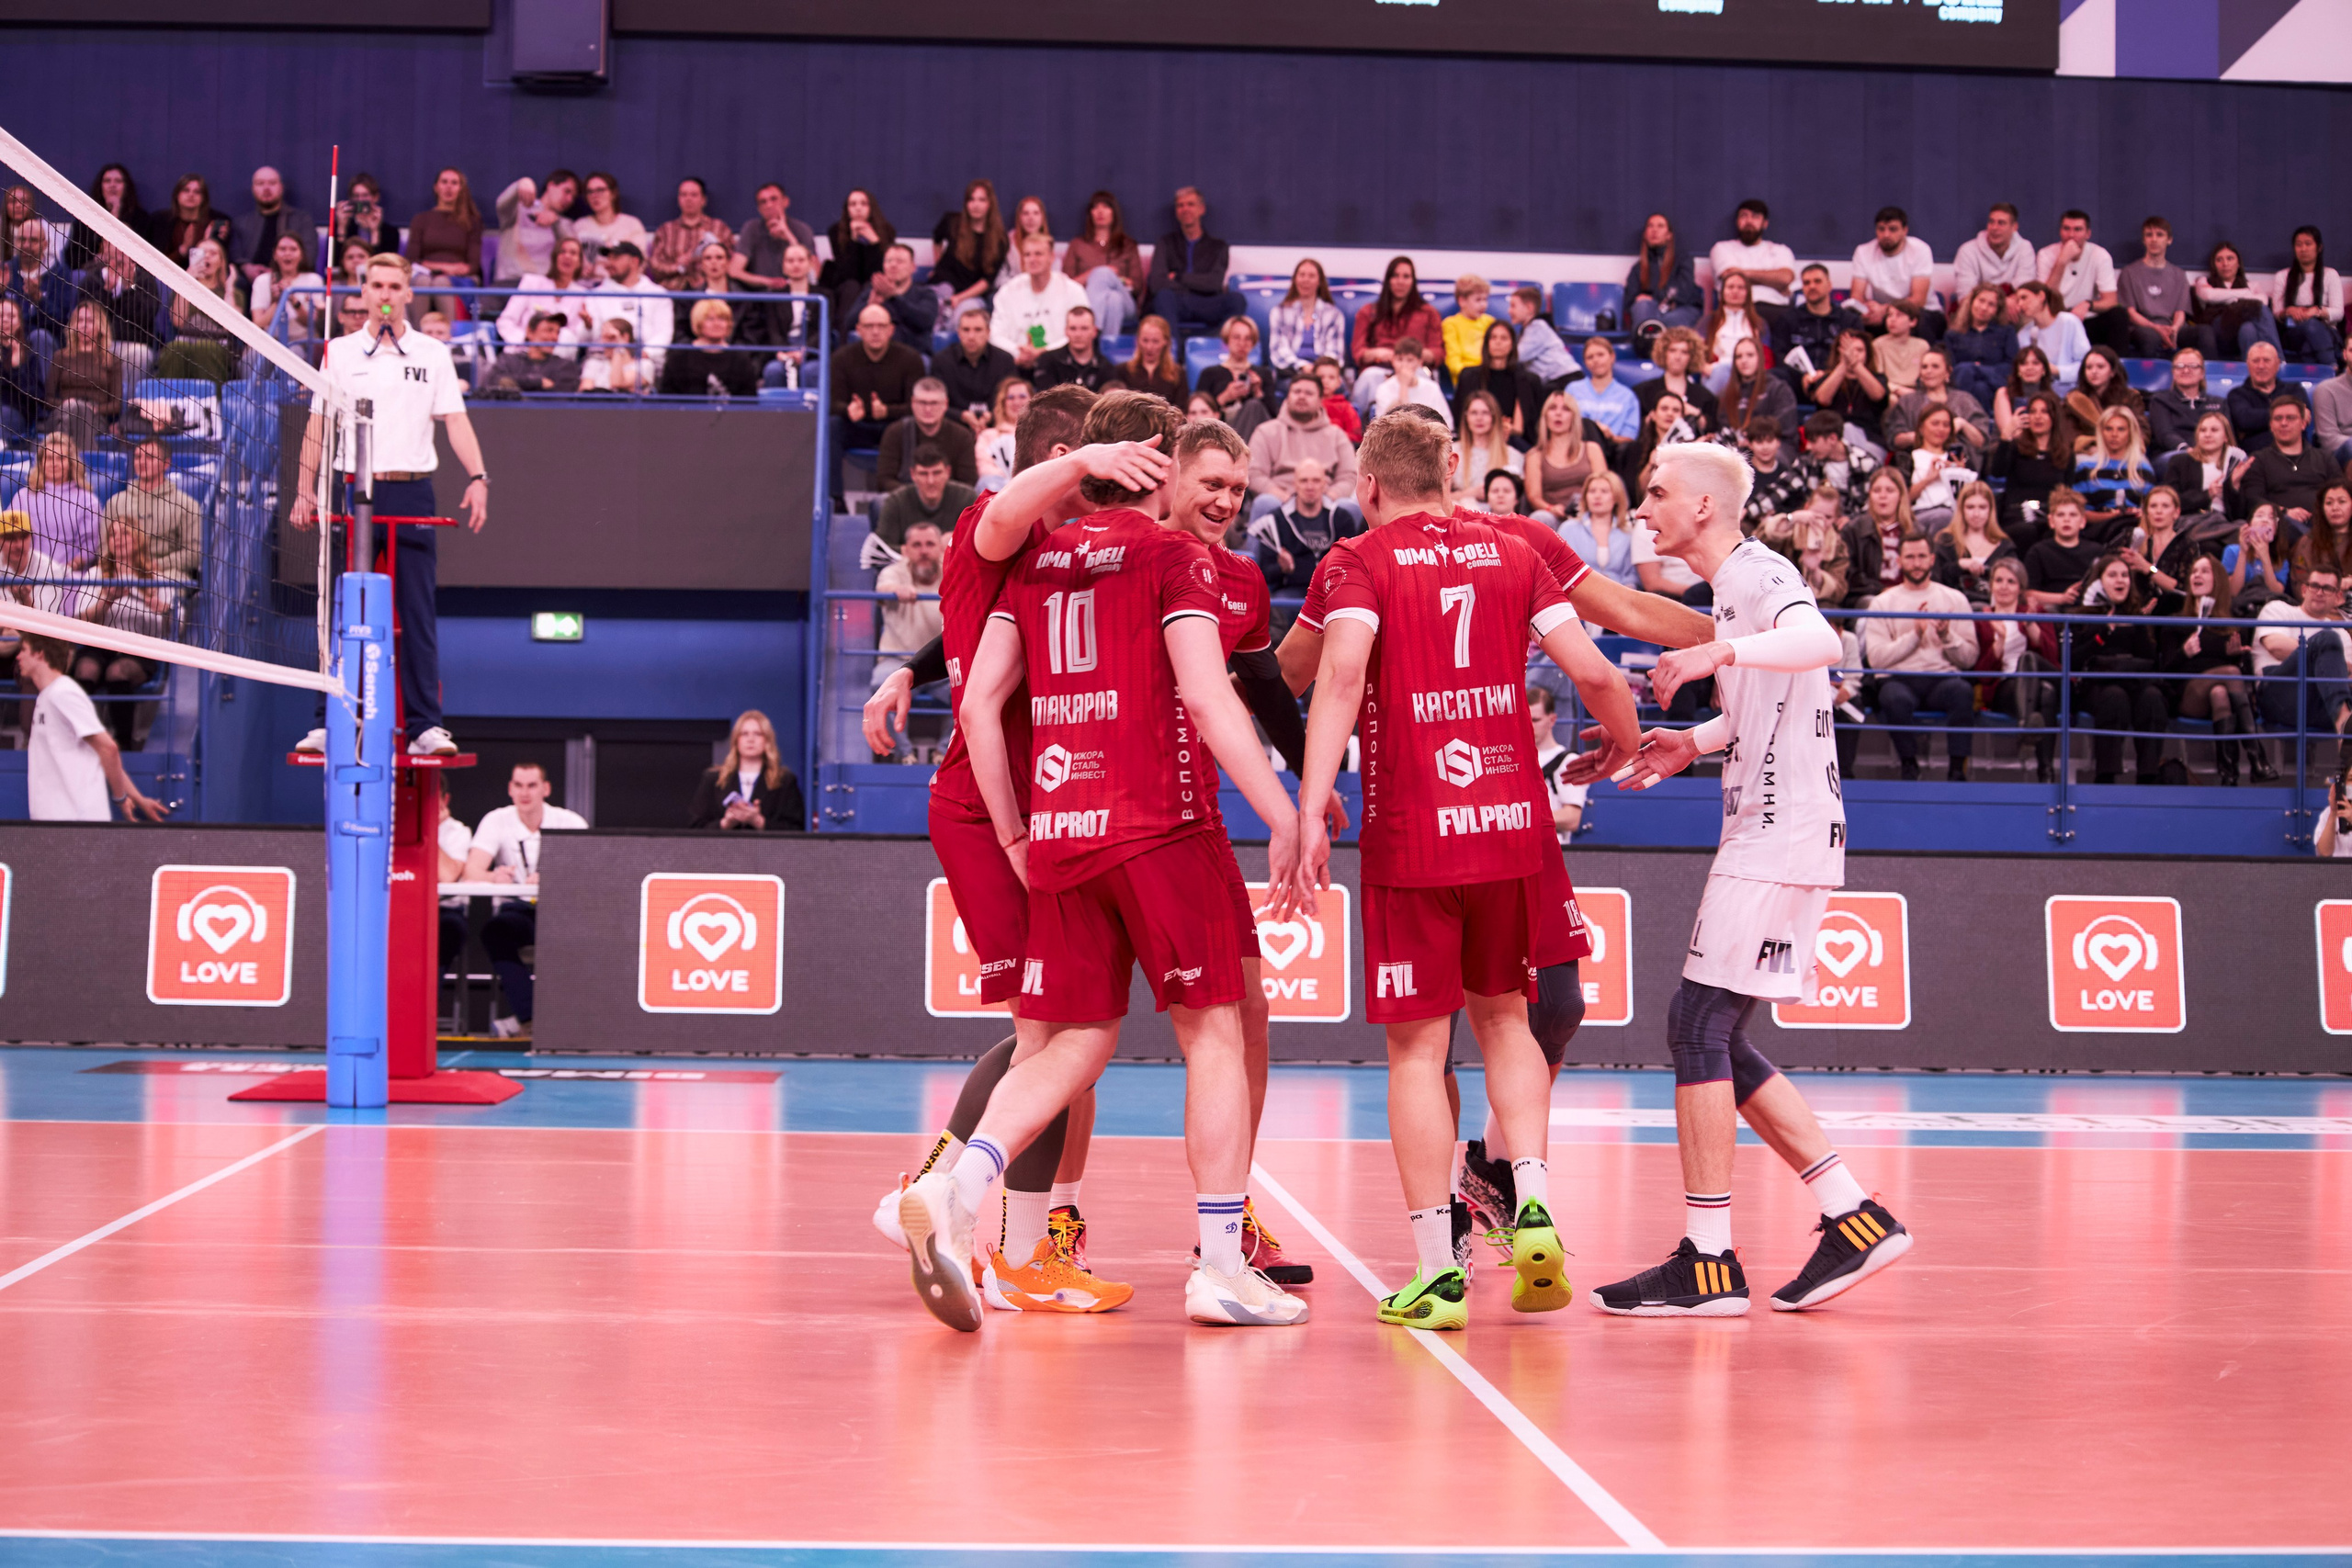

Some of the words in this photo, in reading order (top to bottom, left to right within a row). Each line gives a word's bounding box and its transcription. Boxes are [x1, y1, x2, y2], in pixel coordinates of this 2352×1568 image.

[404, 367, 428, 383] FVL
[1393, 547, 1439, 567] DIMA
[1452, 542, 1499, 564] БОЕЦ
[1043, 588, 1098, 674] 10
[1440, 583, 1476, 669] 7
[365, 660, 379, 719] Senoh
[1031, 690, 1118, 727] МАКАРОВ
[1412, 683, 1517, 723] КАСАТКИ
[1073, 750, 1104, 761] ИЖОРА
[1482, 744, 1514, 755] ИЖОРА
[1484, 754, 1512, 765] СТАЛЬ
[1070, 771, 1106, 780] ИНВЕСТ
[1072, 761, 1100, 771] СТАЛЬ
[1486, 763, 1520, 775] ИНВЕСТ
[390, 870, 415, 881] noh
[980, 958, 1017, 975] SEN
[1754, 940, 1796, 974] FVL
[181, 961, 258, 985] LOVE
[672, 969, 750, 993] LOVE
[1021, 960, 1044, 996] VL
[1377, 964, 1418, 998] FVL
[1261, 976, 1318, 1000] OVE
[2080, 989, 2154, 1011] LOVE
